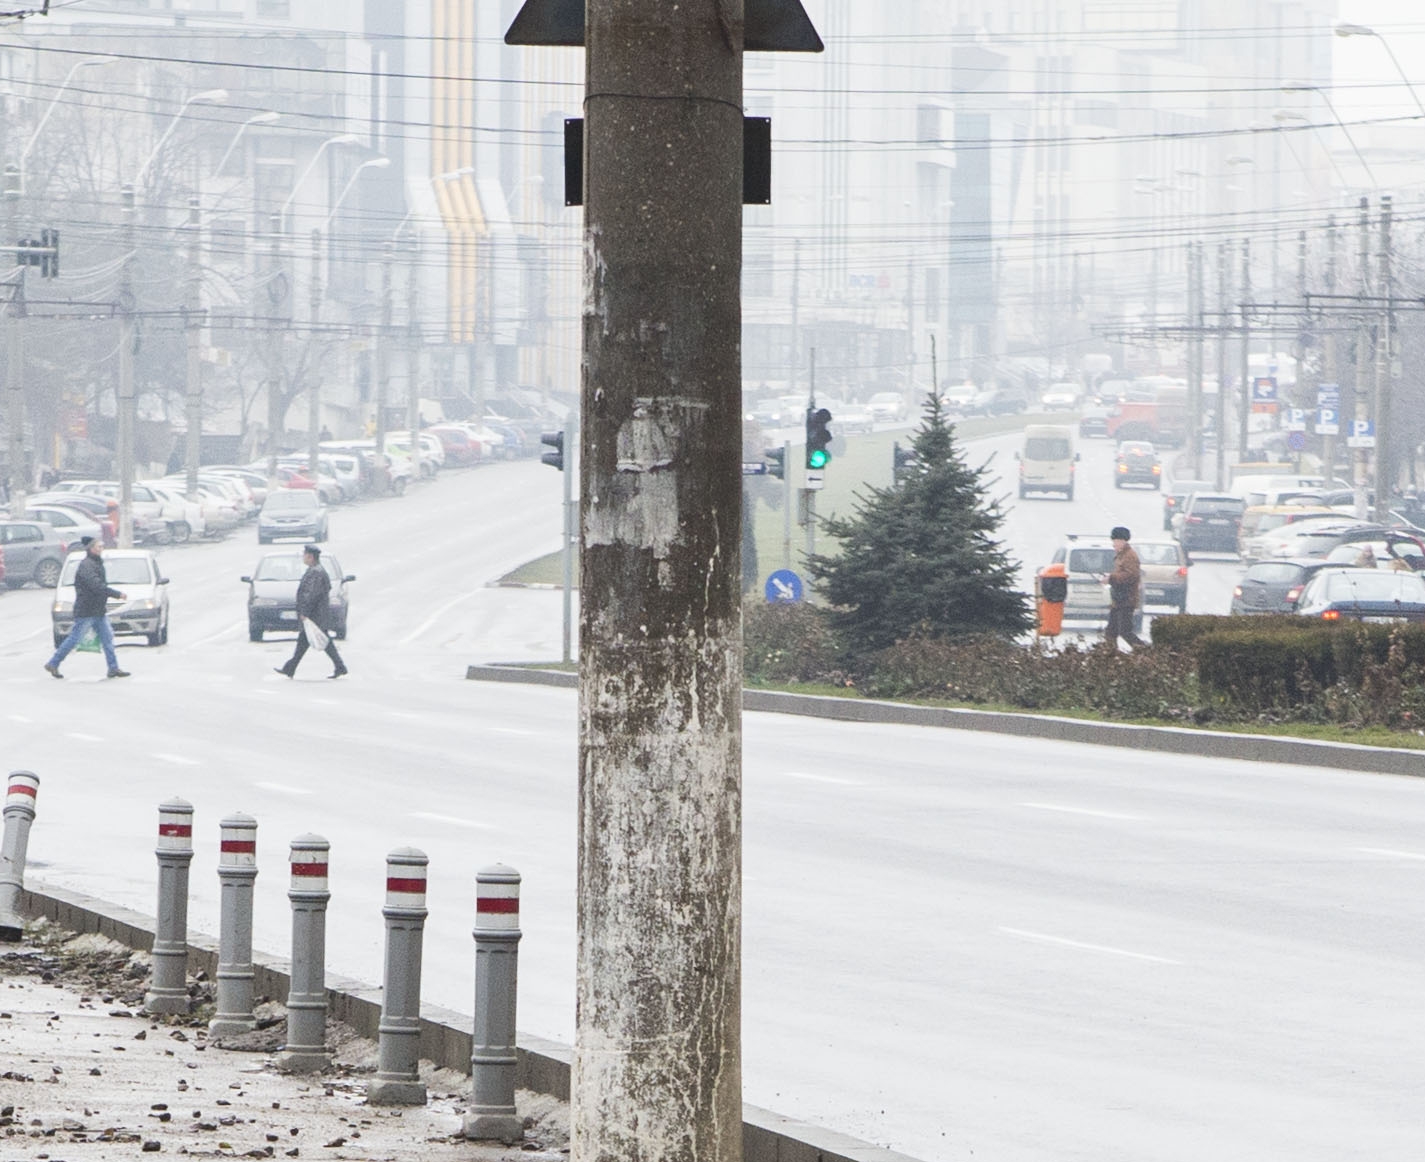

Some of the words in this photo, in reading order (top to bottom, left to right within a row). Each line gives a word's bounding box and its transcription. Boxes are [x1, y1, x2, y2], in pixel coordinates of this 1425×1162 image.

[1292, 408, 1304, 423] P
[1321, 409, 1334, 424] P
[1353, 420, 1369, 437] P
